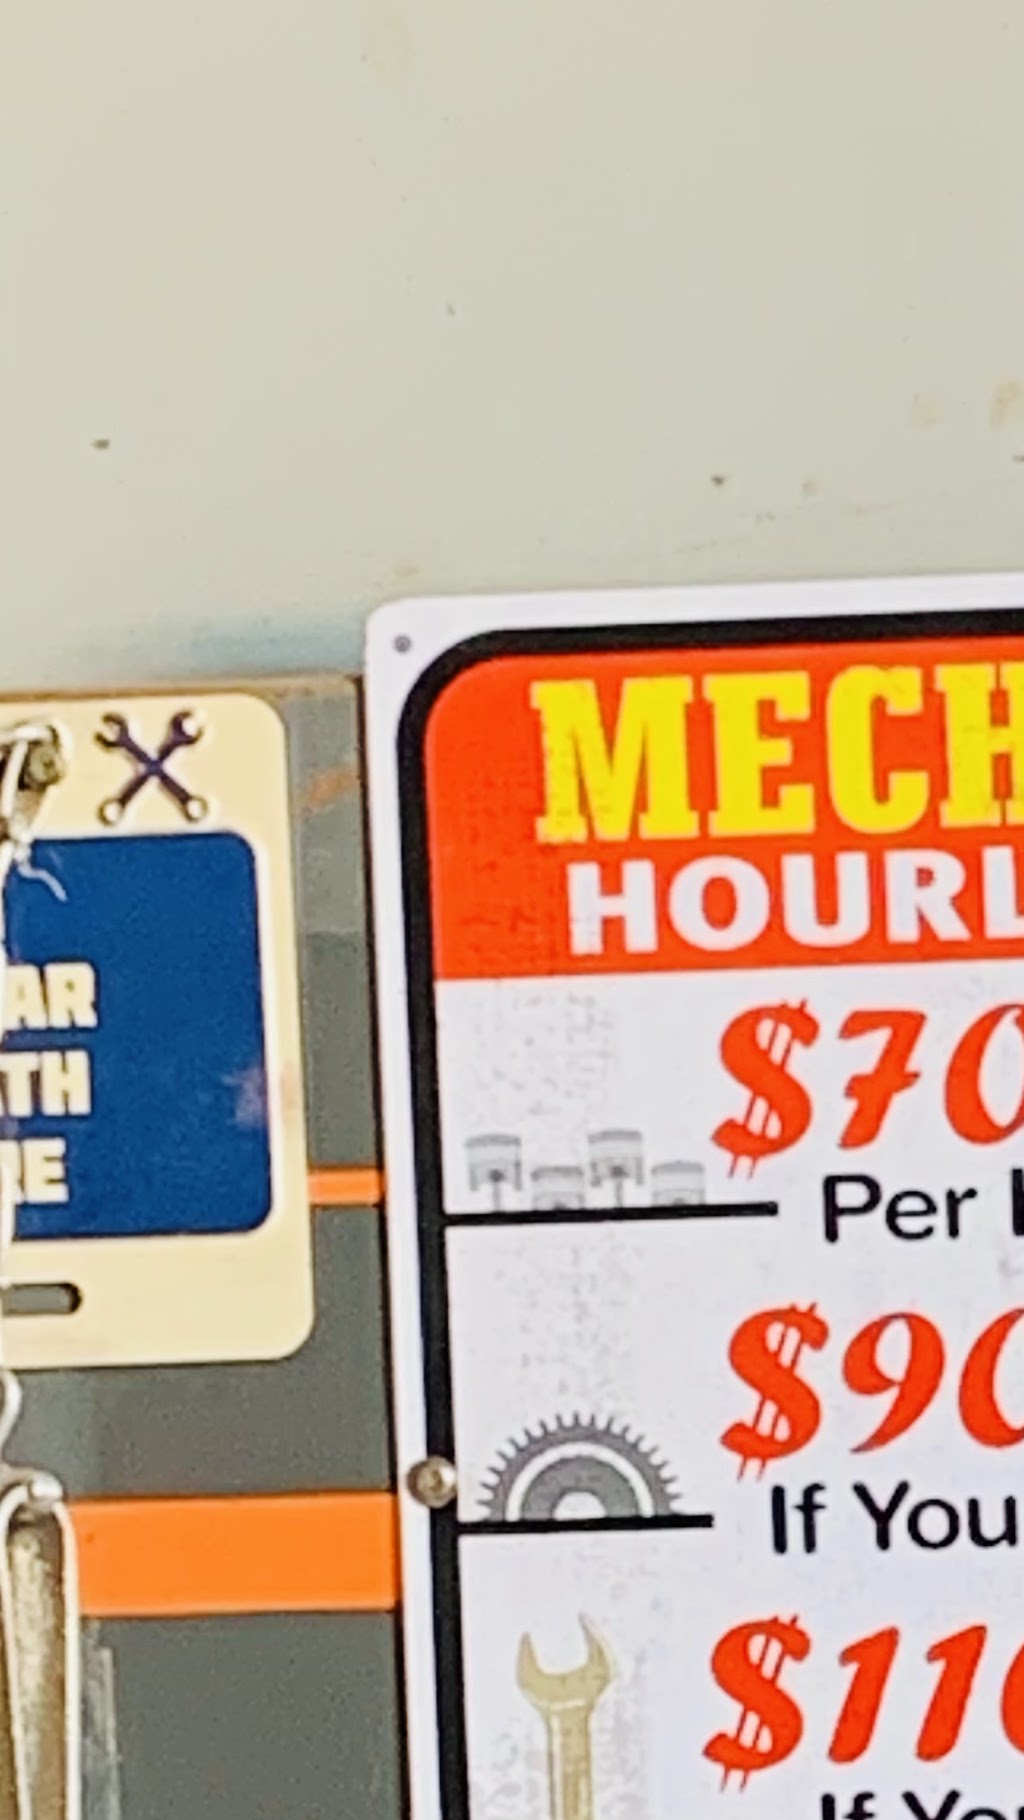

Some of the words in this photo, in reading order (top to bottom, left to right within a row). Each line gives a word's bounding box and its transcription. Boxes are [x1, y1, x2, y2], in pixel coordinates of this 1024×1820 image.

[822, 1174, 978, 1244] Per
[771, 1482, 826, 1555] If
[852, 1481, 1018, 1551] You
